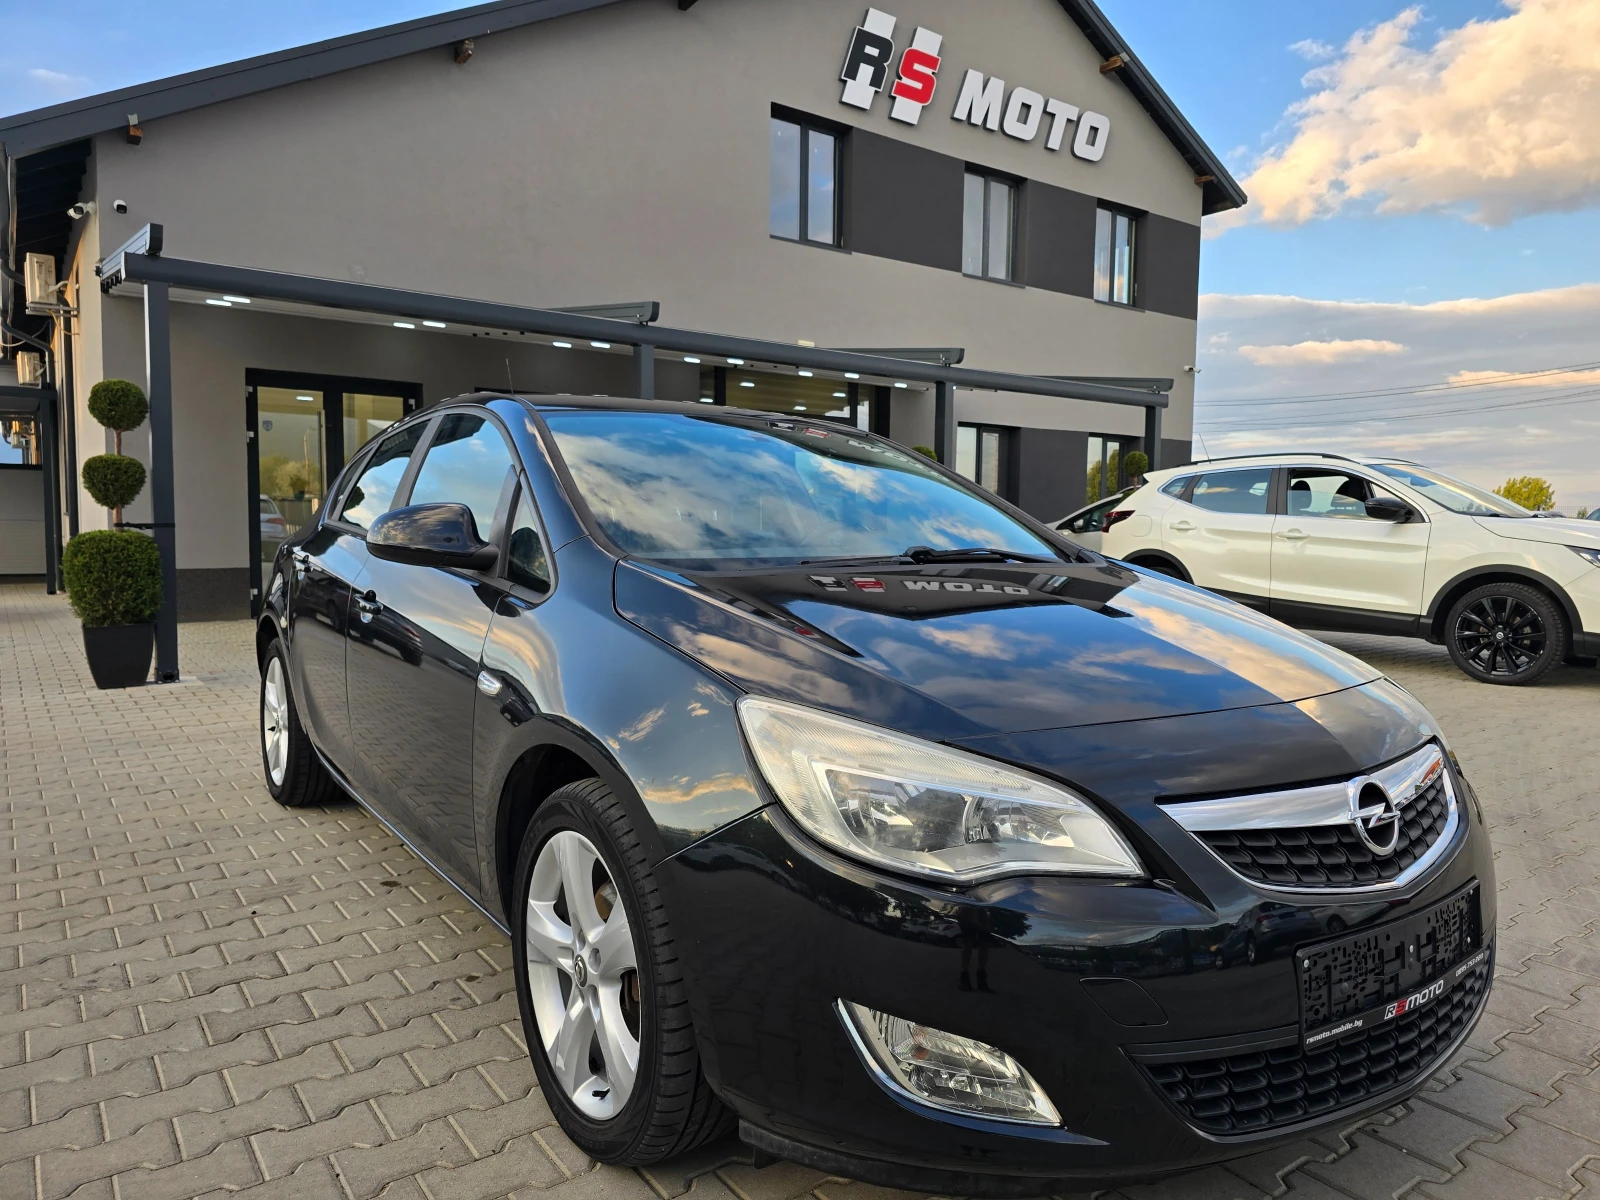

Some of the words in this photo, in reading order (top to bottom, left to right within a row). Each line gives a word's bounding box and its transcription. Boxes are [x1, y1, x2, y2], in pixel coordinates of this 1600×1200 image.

[841, 25, 941, 106] RS
[952, 68, 1111, 162] MOTO
[1305, 1019, 1363, 1045] rsmoto.mobile.bg
